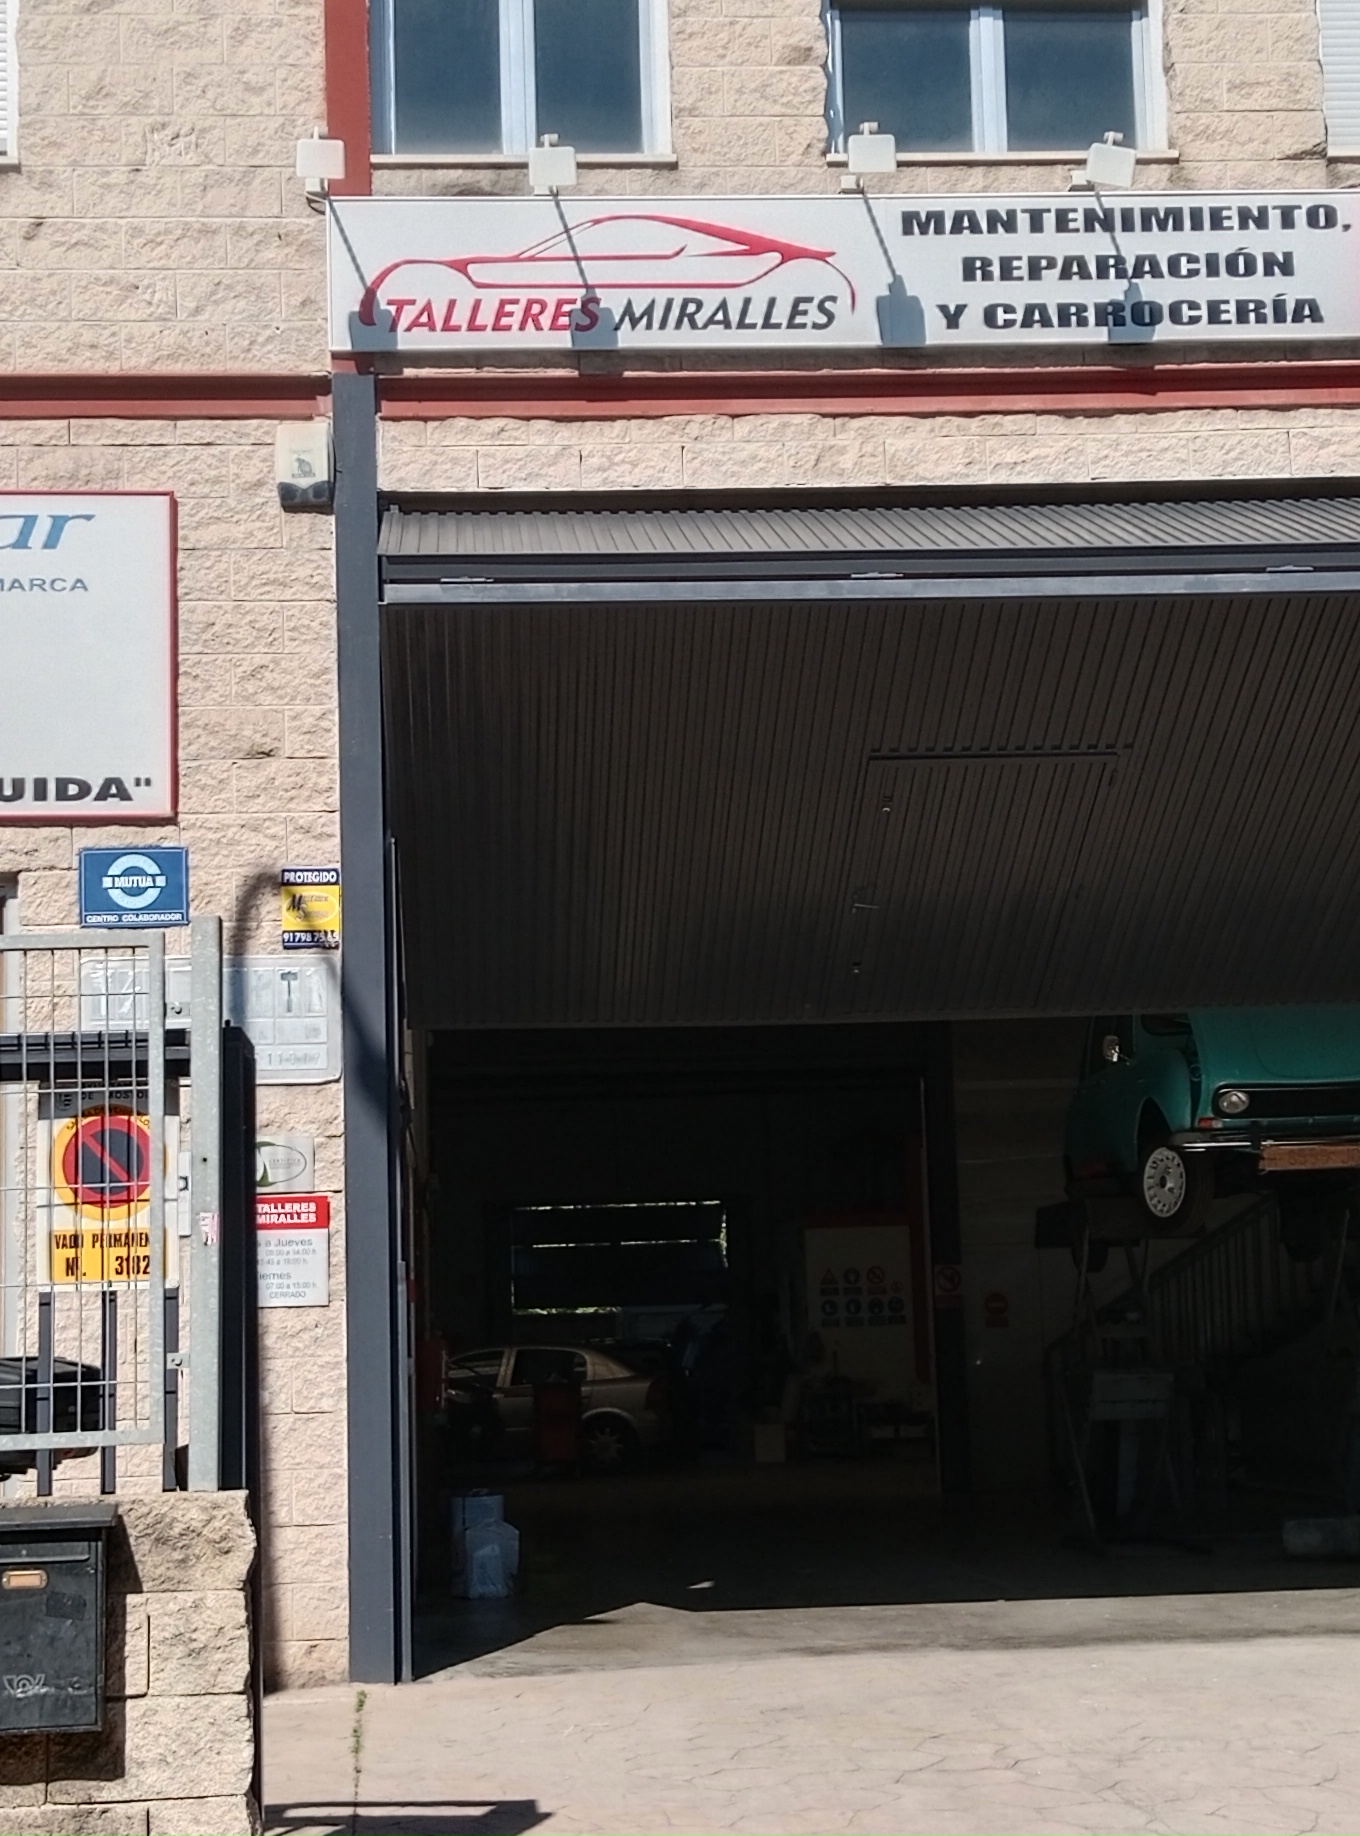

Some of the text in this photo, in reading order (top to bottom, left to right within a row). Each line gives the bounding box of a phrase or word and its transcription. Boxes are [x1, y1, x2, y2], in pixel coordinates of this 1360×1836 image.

[901, 204, 1351, 236] MANTENIMIENTO,
[961, 247, 1295, 282] REPARACIÓN
[386, 295, 839, 333] TALLERES MIRALLES
[935, 293, 1325, 330] Y CARROCERÍA
[115, 875, 154, 888] MUTUA
[283, 871, 337, 883] PROTEGIDO
[86, 912, 183, 923] CENTRO COLABORADOR
[257, 1203, 316, 1213] TALLERES
[256, 1213, 316, 1224] MIRALLES
[55, 1234, 84, 1249] VADO
[274, 1238, 313, 1247] Jueves
[259, 1272, 292, 1280] iernes
[269, 1290, 306, 1299] CERRADO
